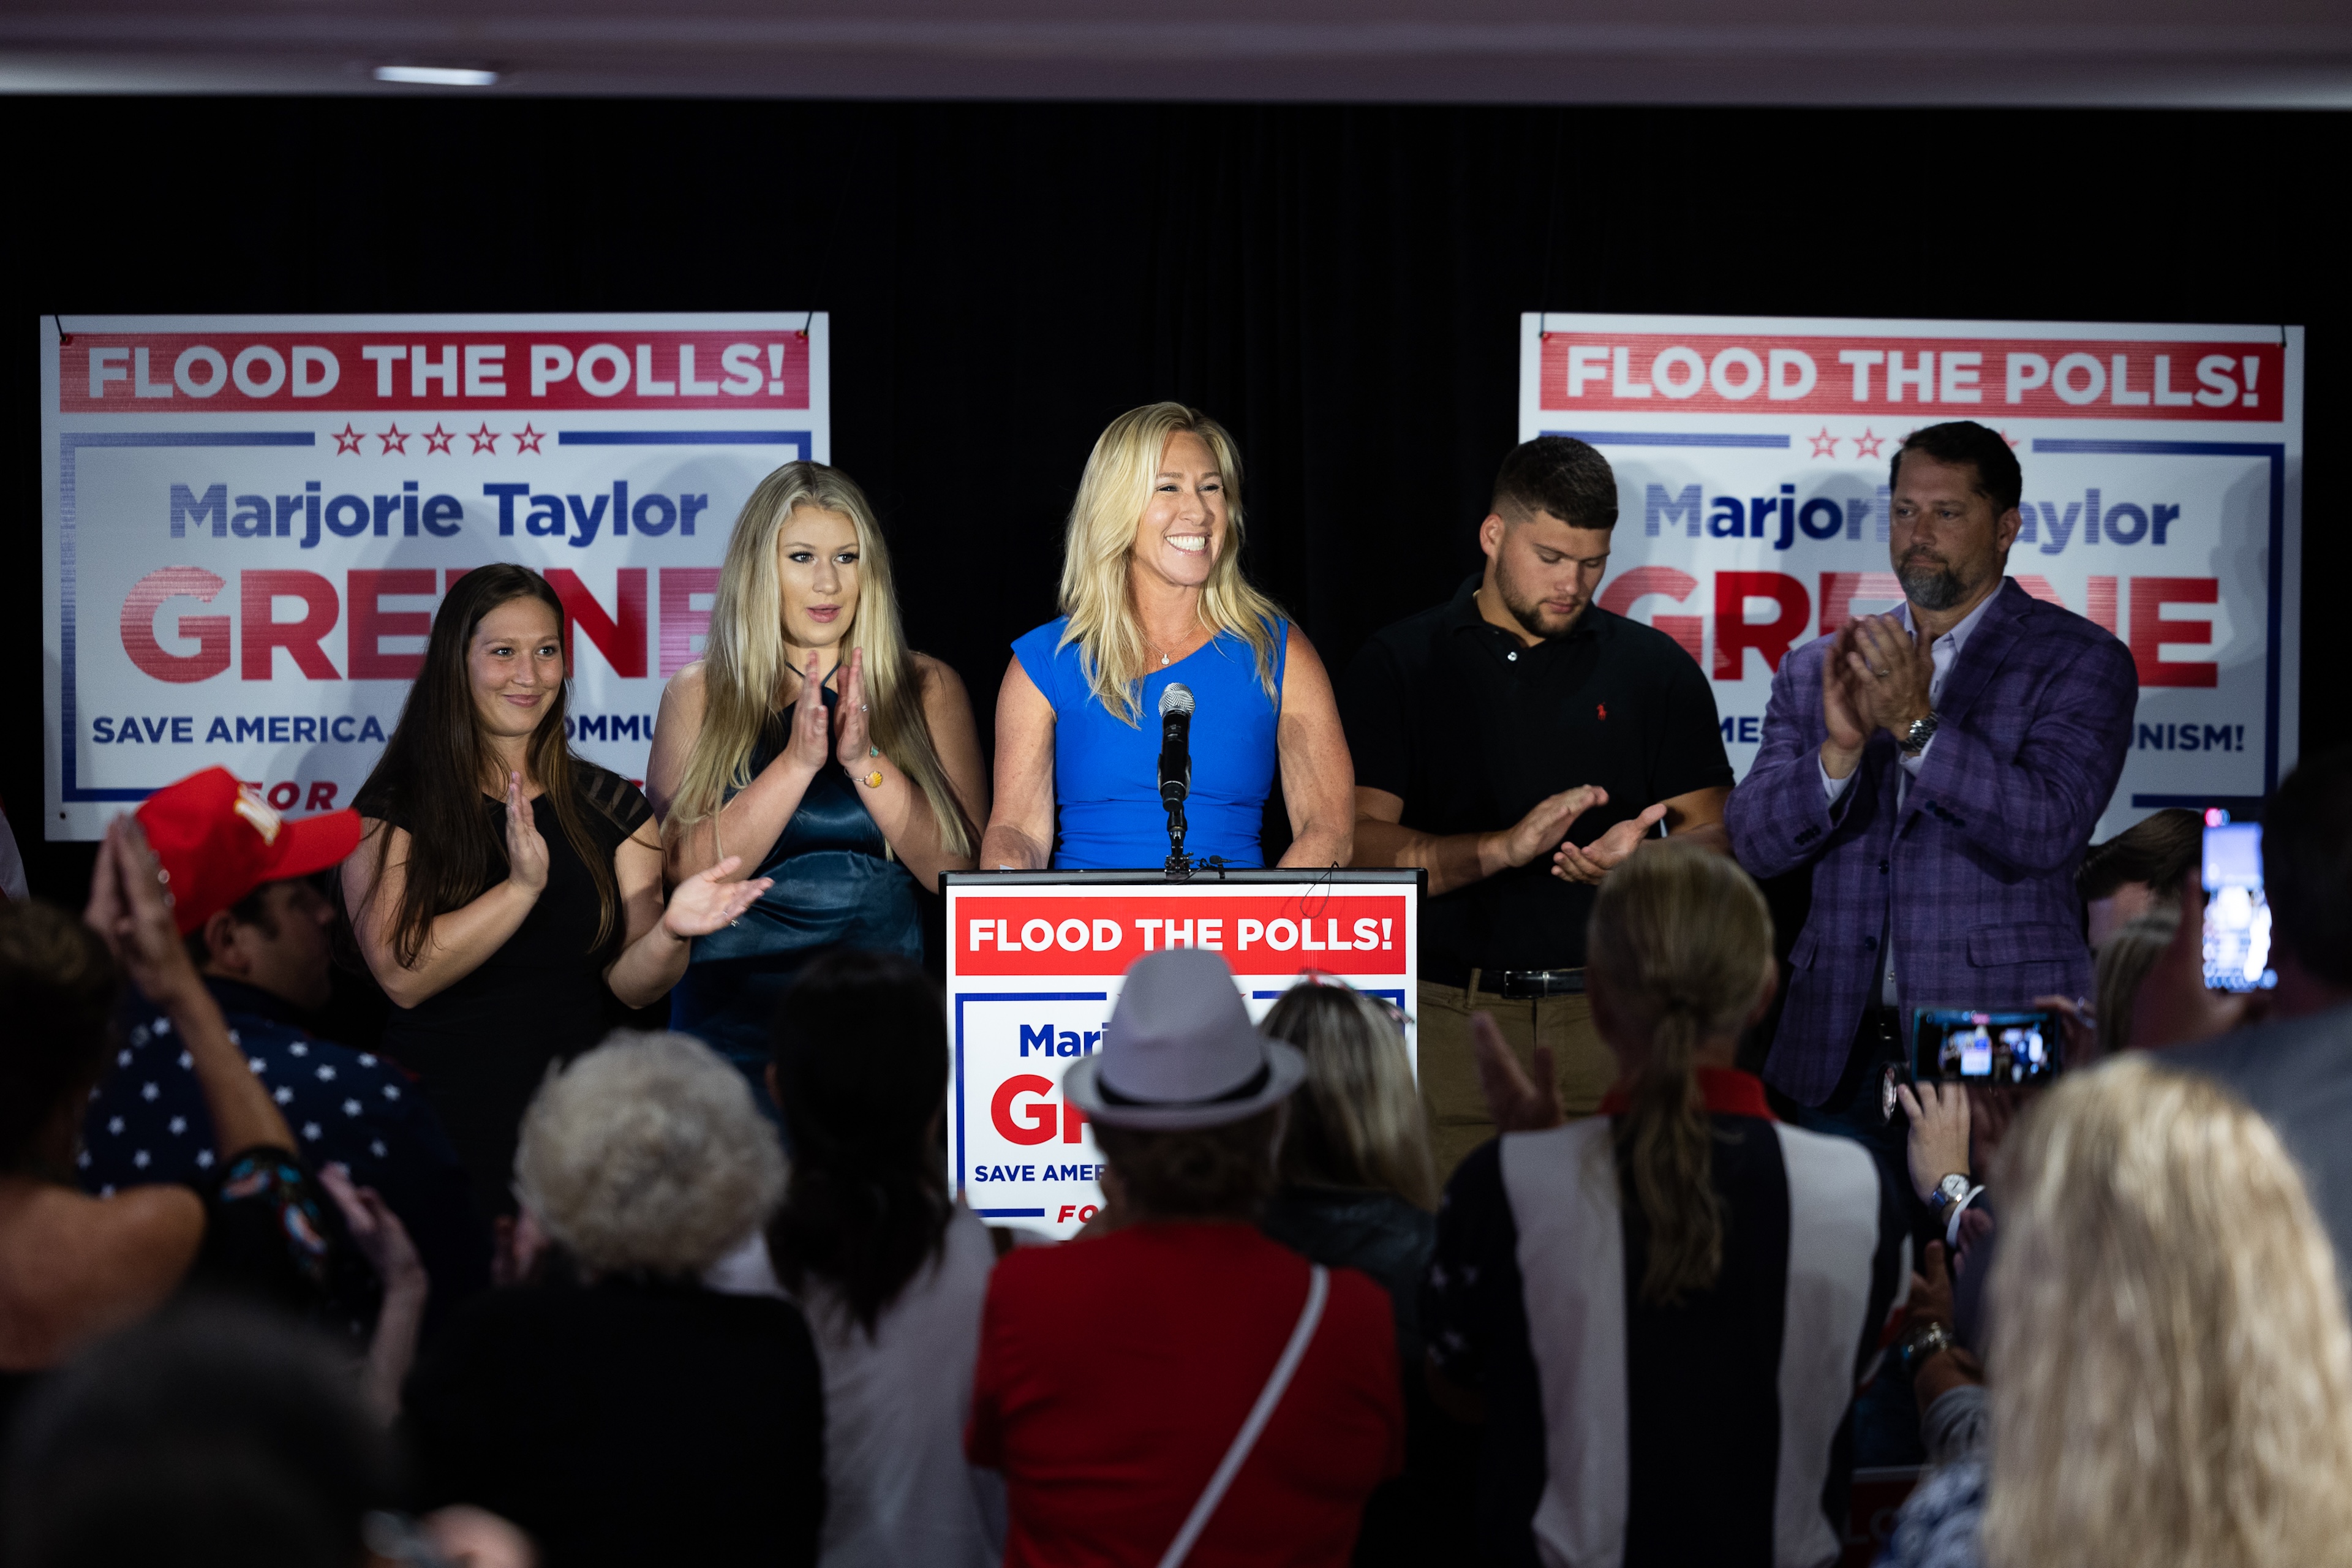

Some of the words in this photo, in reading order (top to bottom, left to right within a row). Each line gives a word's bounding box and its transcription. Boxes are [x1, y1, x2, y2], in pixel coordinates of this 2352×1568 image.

[88, 345, 340, 399] FLOOD
[362, 345, 507, 398] THE
[530, 342, 785, 398] POLLS!
[1567, 345, 1818, 401] FLOOD
[1839, 349, 1983, 404] THE
[2005, 352, 2260, 407] POLLS!
[169, 480, 464, 549] Marjorie
[483, 479, 709, 548] Taylor
[1644, 483, 1891, 551] Marjori
[2015, 488, 2180, 556] aylor
[120, 565, 723, 684] GRENE
[92, 715, 194, 744] SAVE
[2129, 723, 2245, 752] NISM!
[970, 918, 1123, 951] FLOOD
[1135, 918, 1223, 951] THE
[1237, 918, 1392, 951] POLLS!
[974, 1165, 1035, 1182] SAVE
[1042, 1164, 1106, 1182] AMER
[1057, 1204, 1099, 1223] FO
